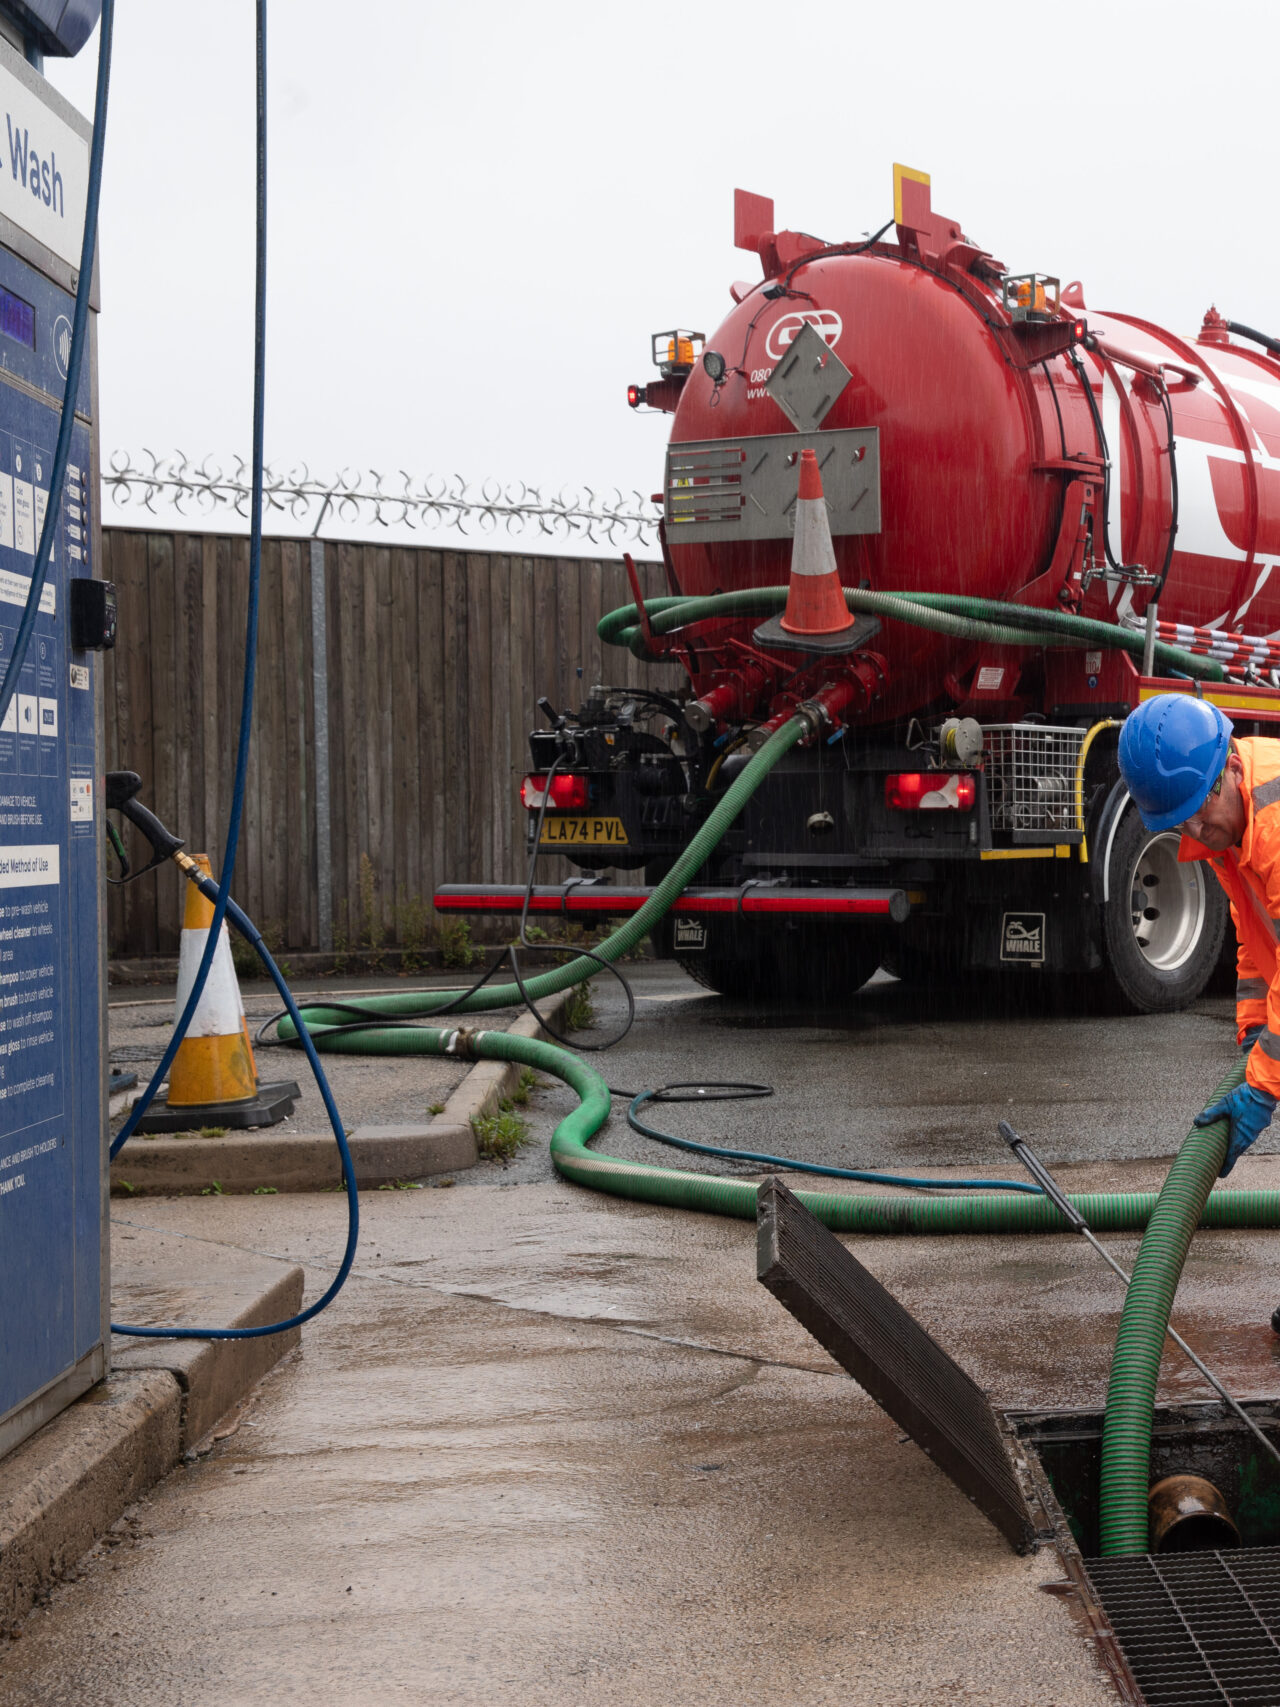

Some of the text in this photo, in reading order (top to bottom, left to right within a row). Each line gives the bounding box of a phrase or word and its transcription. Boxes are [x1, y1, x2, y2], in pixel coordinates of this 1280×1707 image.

[6, 112, 64, 219] Wash
[548, 821, 588, 841] LA74
[594, 821, 625, 841] PVL
[11, 859, 31, 873] Method
[32, 857, 38, 872] of
[39, 857, 48, 872] Use
[11, 902, 32, 919] pre-wash
[33, 900, 48, 914] vehicle
[14, 926, 31, 939] cleaner
[32, 925, 38, 937] to
[38, 922, 53, 936] wheels
[678, 929, 703, 941] WHALE
[1006, 940, 1041, 953] WHALE
[25, 969, 38, 981] cover
[38, 964, 53, 978] vehicle
[4, 993, 19, 1008] brush
[25, 990, 38, 1003] brush
[38, 986, 53, 1000] vehicle
[7, 1018, 12, 1030] to
[13, 1014, 24, 1028] wash
[32, 1010, 52, 1024] shampoo
[8, 1040, 20, 1056] gloss
[21, 1037, 26, 1050] to
[27, 1035, 38, 1048] rinse
[38, 1030, 53, 1044] vehicle
[8, 1086, 14, 1097] to
[14, 1078, 36, 1095] complete
[36, 1072, 55, 1087] cleaning
[0, 1137, 57, 1170] ANCE AND BRUSH TO HOLDERS
